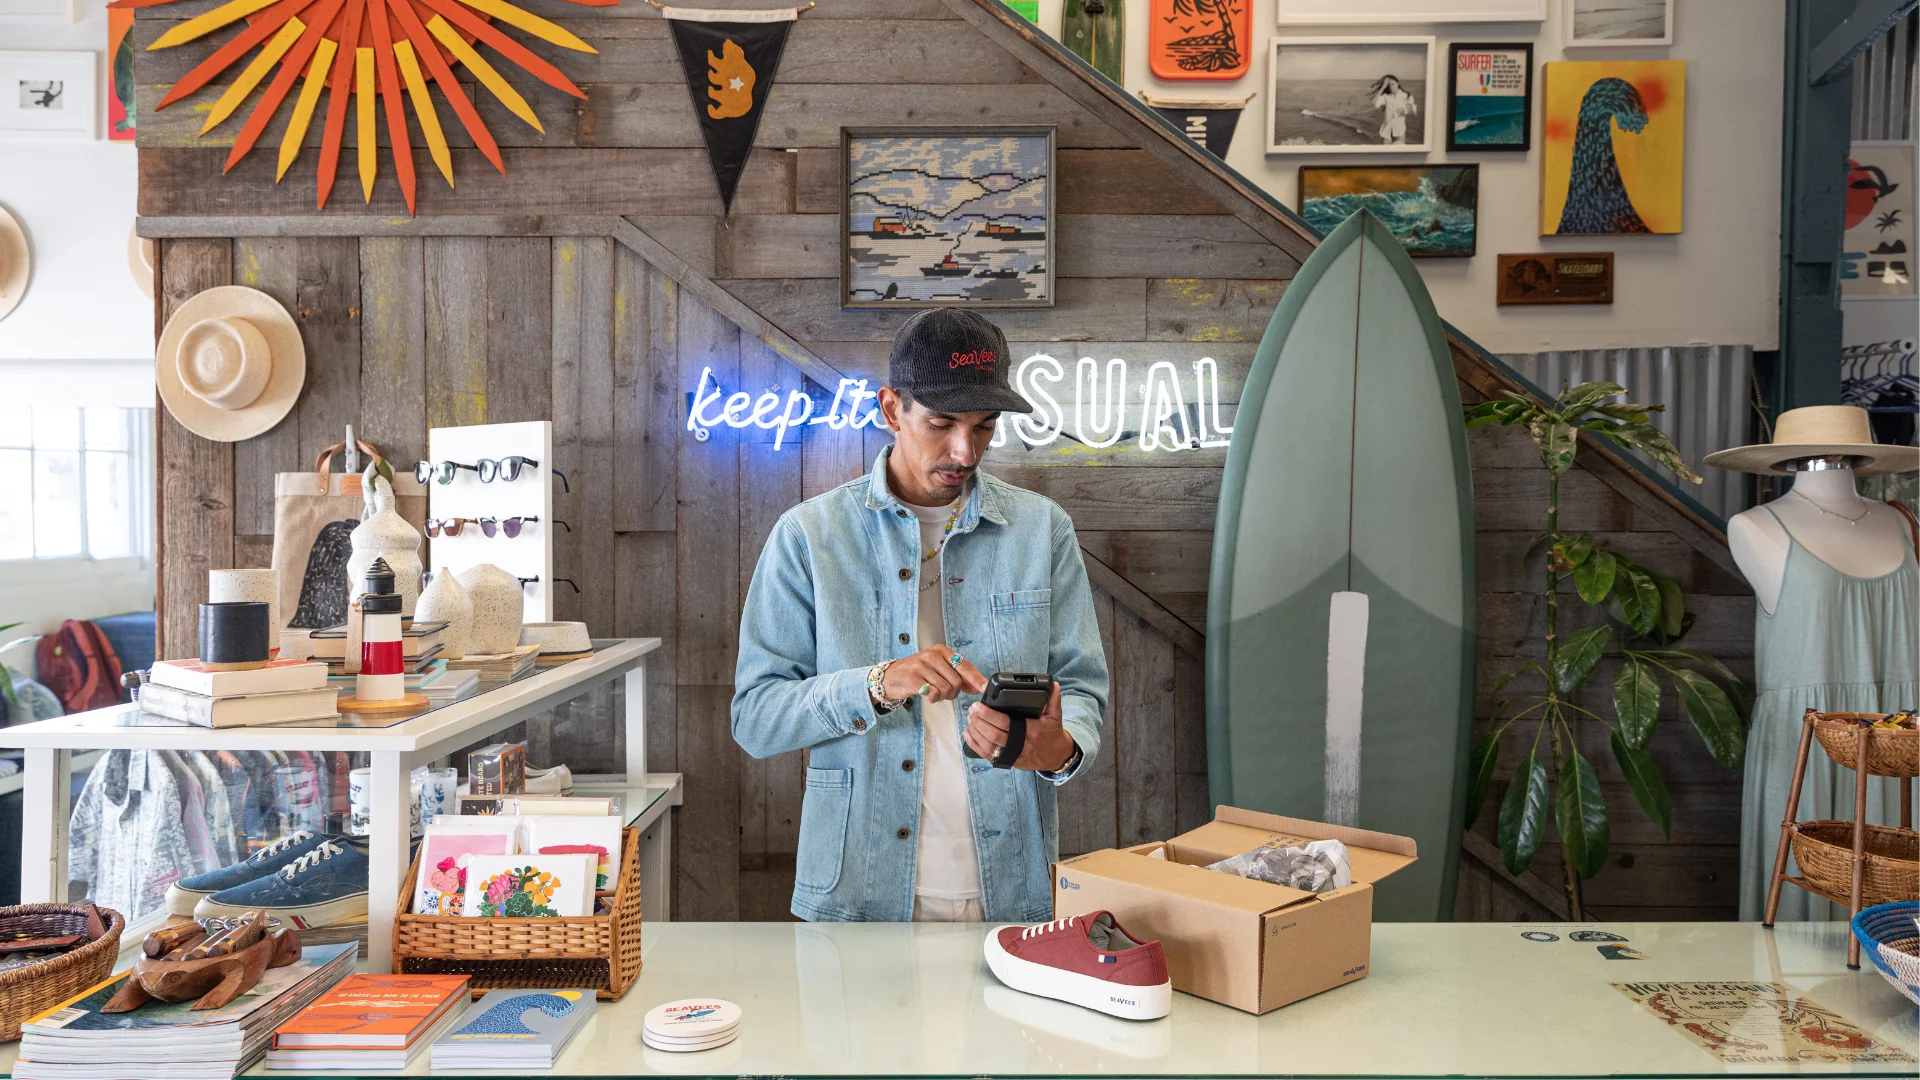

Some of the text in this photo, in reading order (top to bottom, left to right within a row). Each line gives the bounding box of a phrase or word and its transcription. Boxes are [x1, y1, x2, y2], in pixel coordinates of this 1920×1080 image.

[1458, 54, 1491, 70] SURFER
[687, 366, 814, 451] keep
[989, 354, 1234, 451] SUAL
[1625, 982, 1689, 996] HOME
[1110, 996, 1136, 1006] SEAVEES
[664, 1004, 722, 1013] SEAVEES
